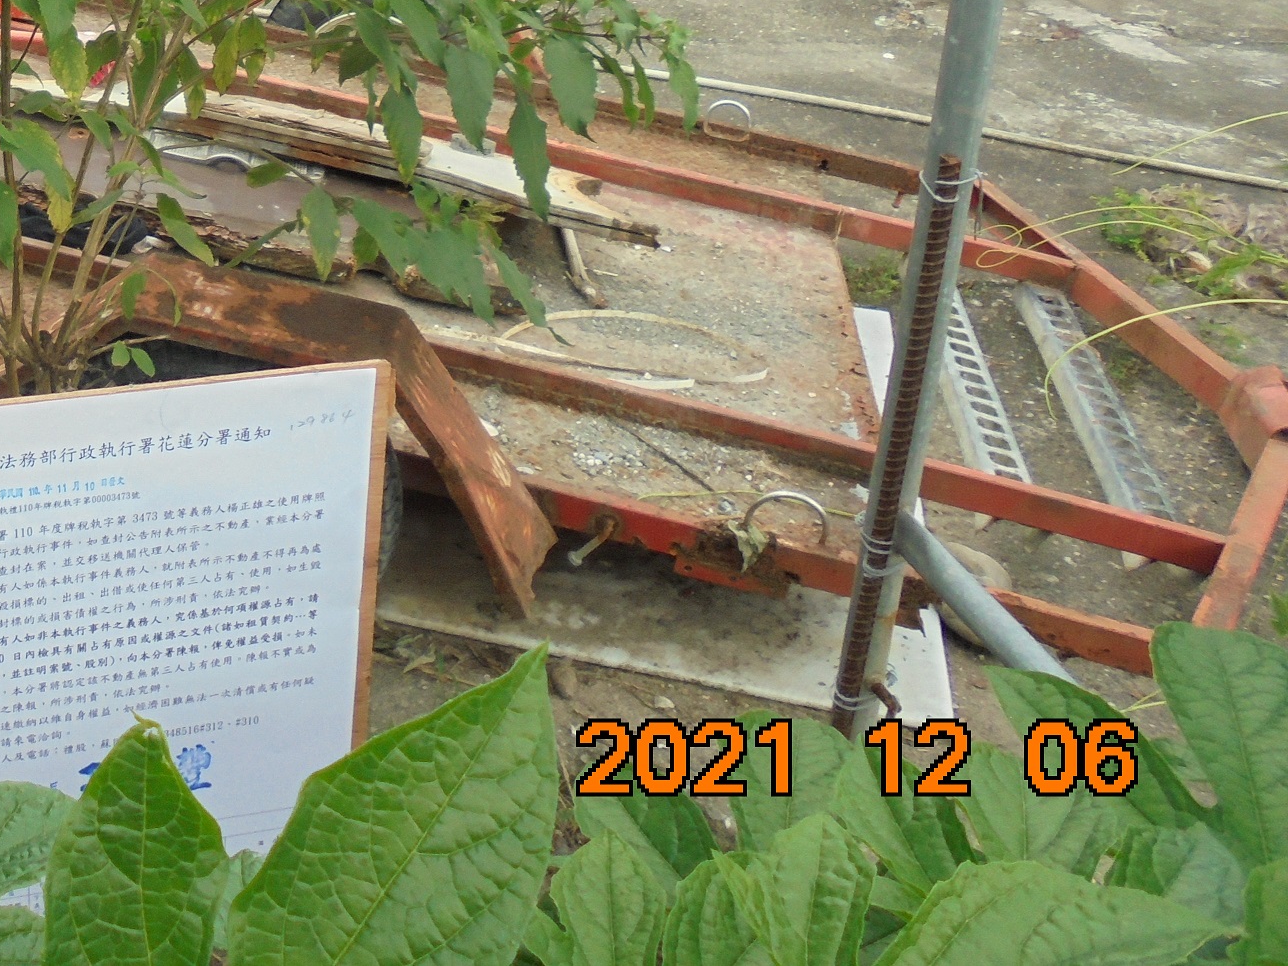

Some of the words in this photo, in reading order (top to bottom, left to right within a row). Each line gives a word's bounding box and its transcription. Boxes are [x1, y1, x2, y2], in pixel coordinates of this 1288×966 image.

[0, 423, 271, 471] 法務部行政執行署花蓮分署通知
